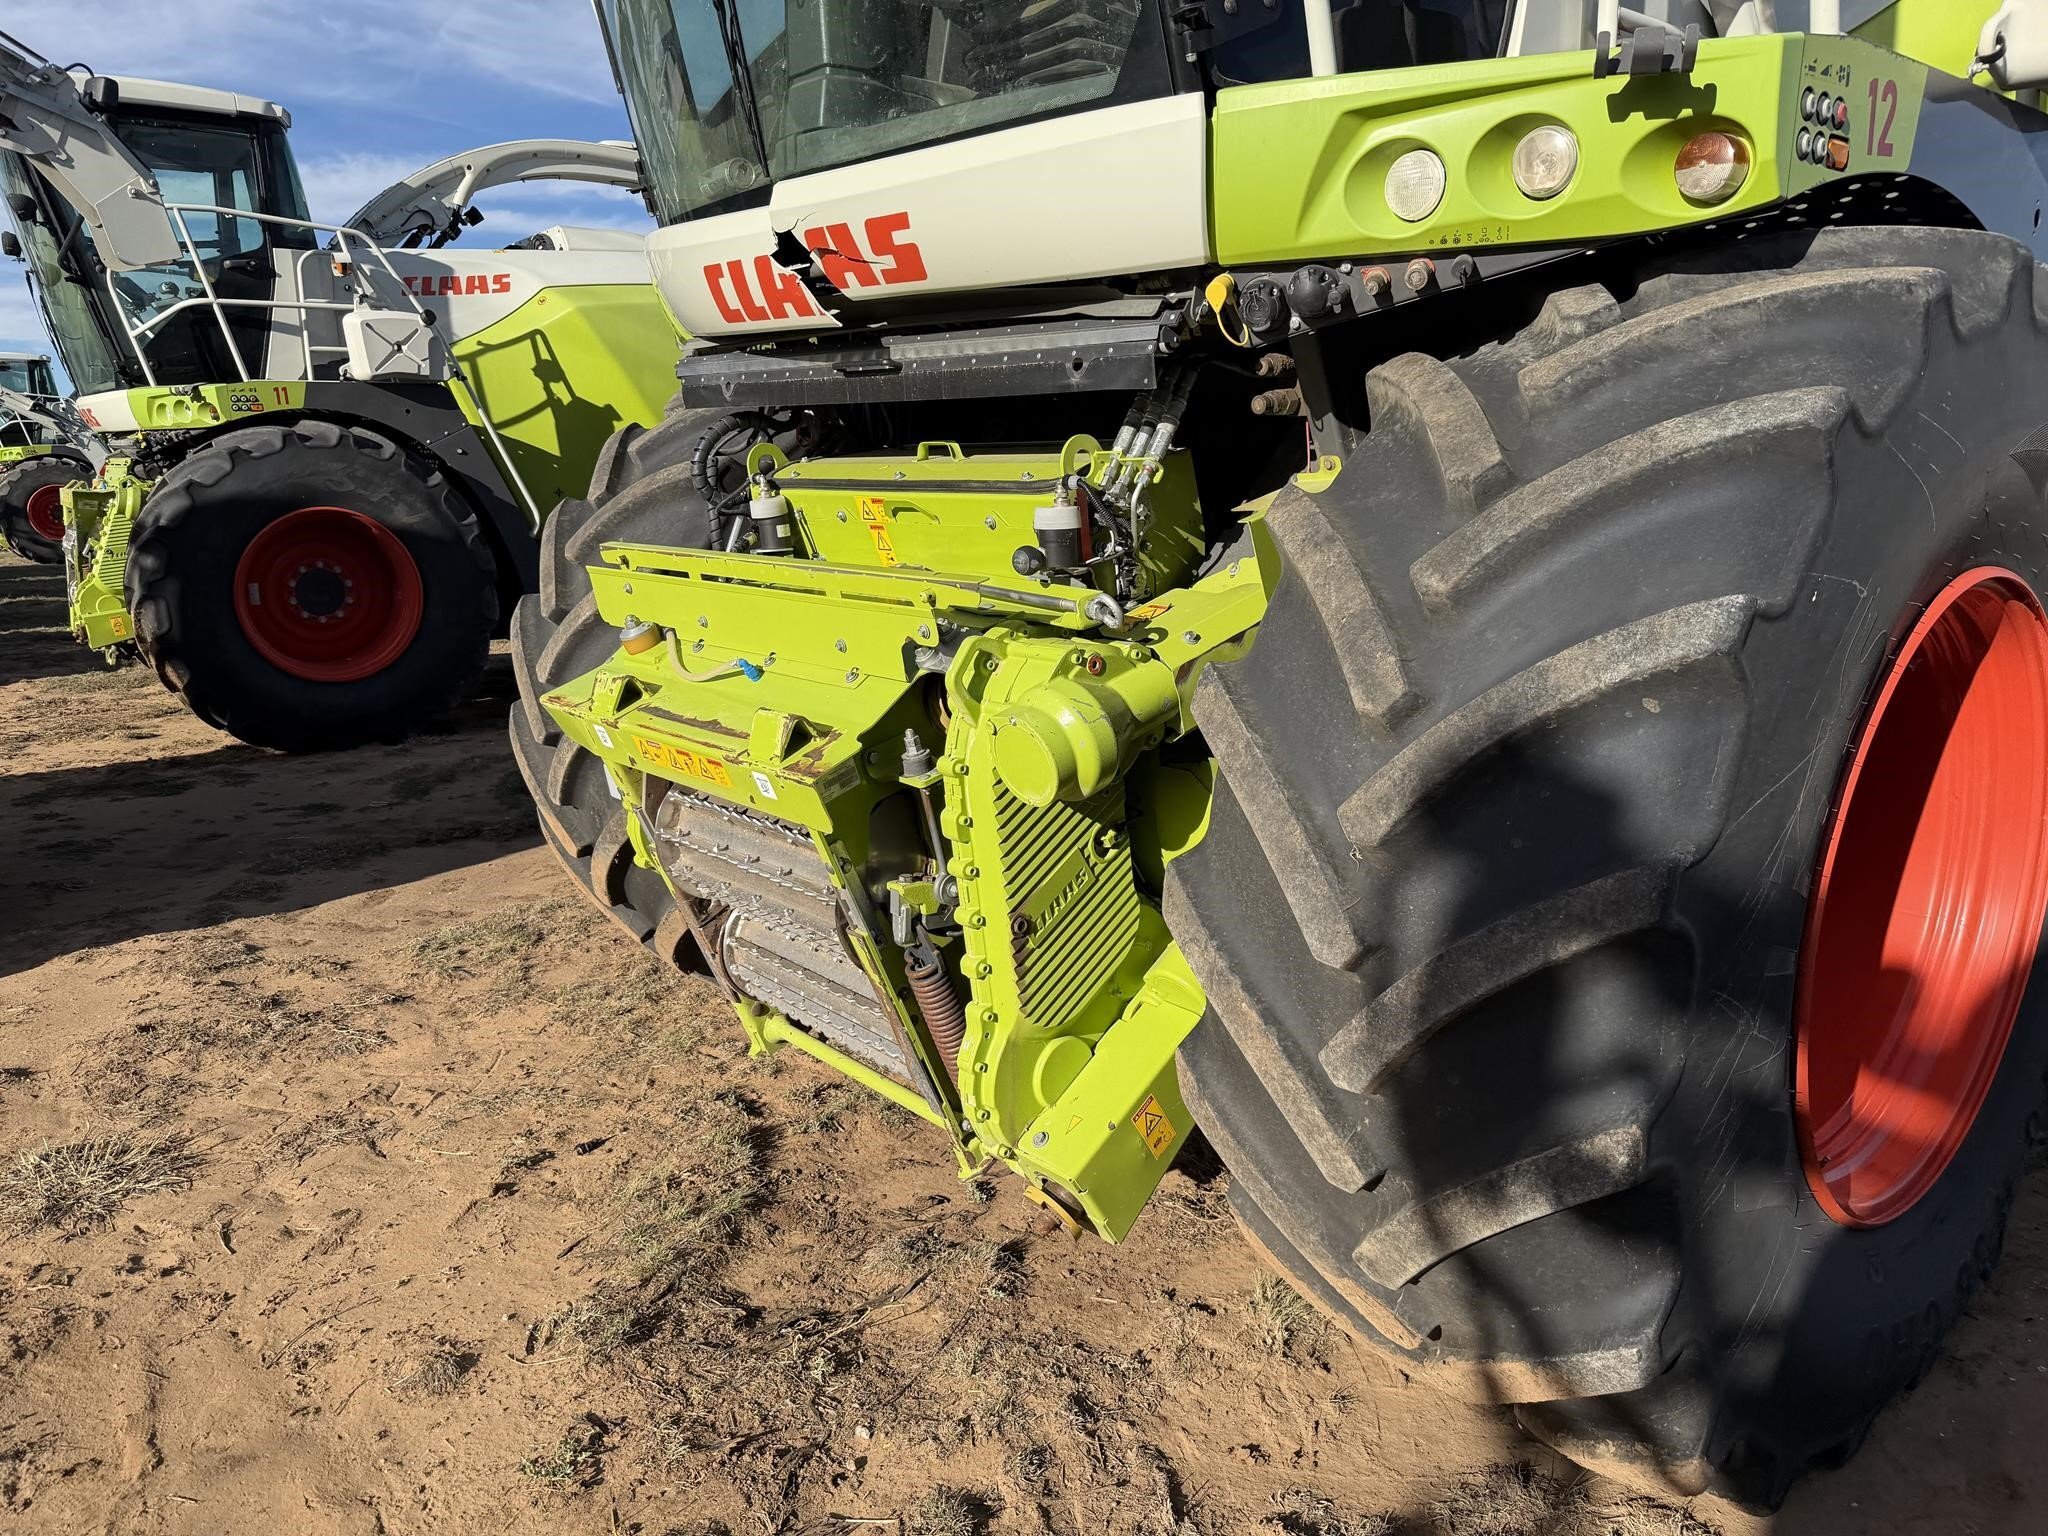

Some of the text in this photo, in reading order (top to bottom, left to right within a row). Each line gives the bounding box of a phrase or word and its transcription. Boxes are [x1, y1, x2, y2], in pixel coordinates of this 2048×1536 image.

[1866, 77, 1898, 158] 12
[401, 273, 511, 297] CLAAS
[703, 211, 928, 324] CLAAS
[272, 386, 289, 405] 11
[1034, 866, 1089, 938] CLAAS
